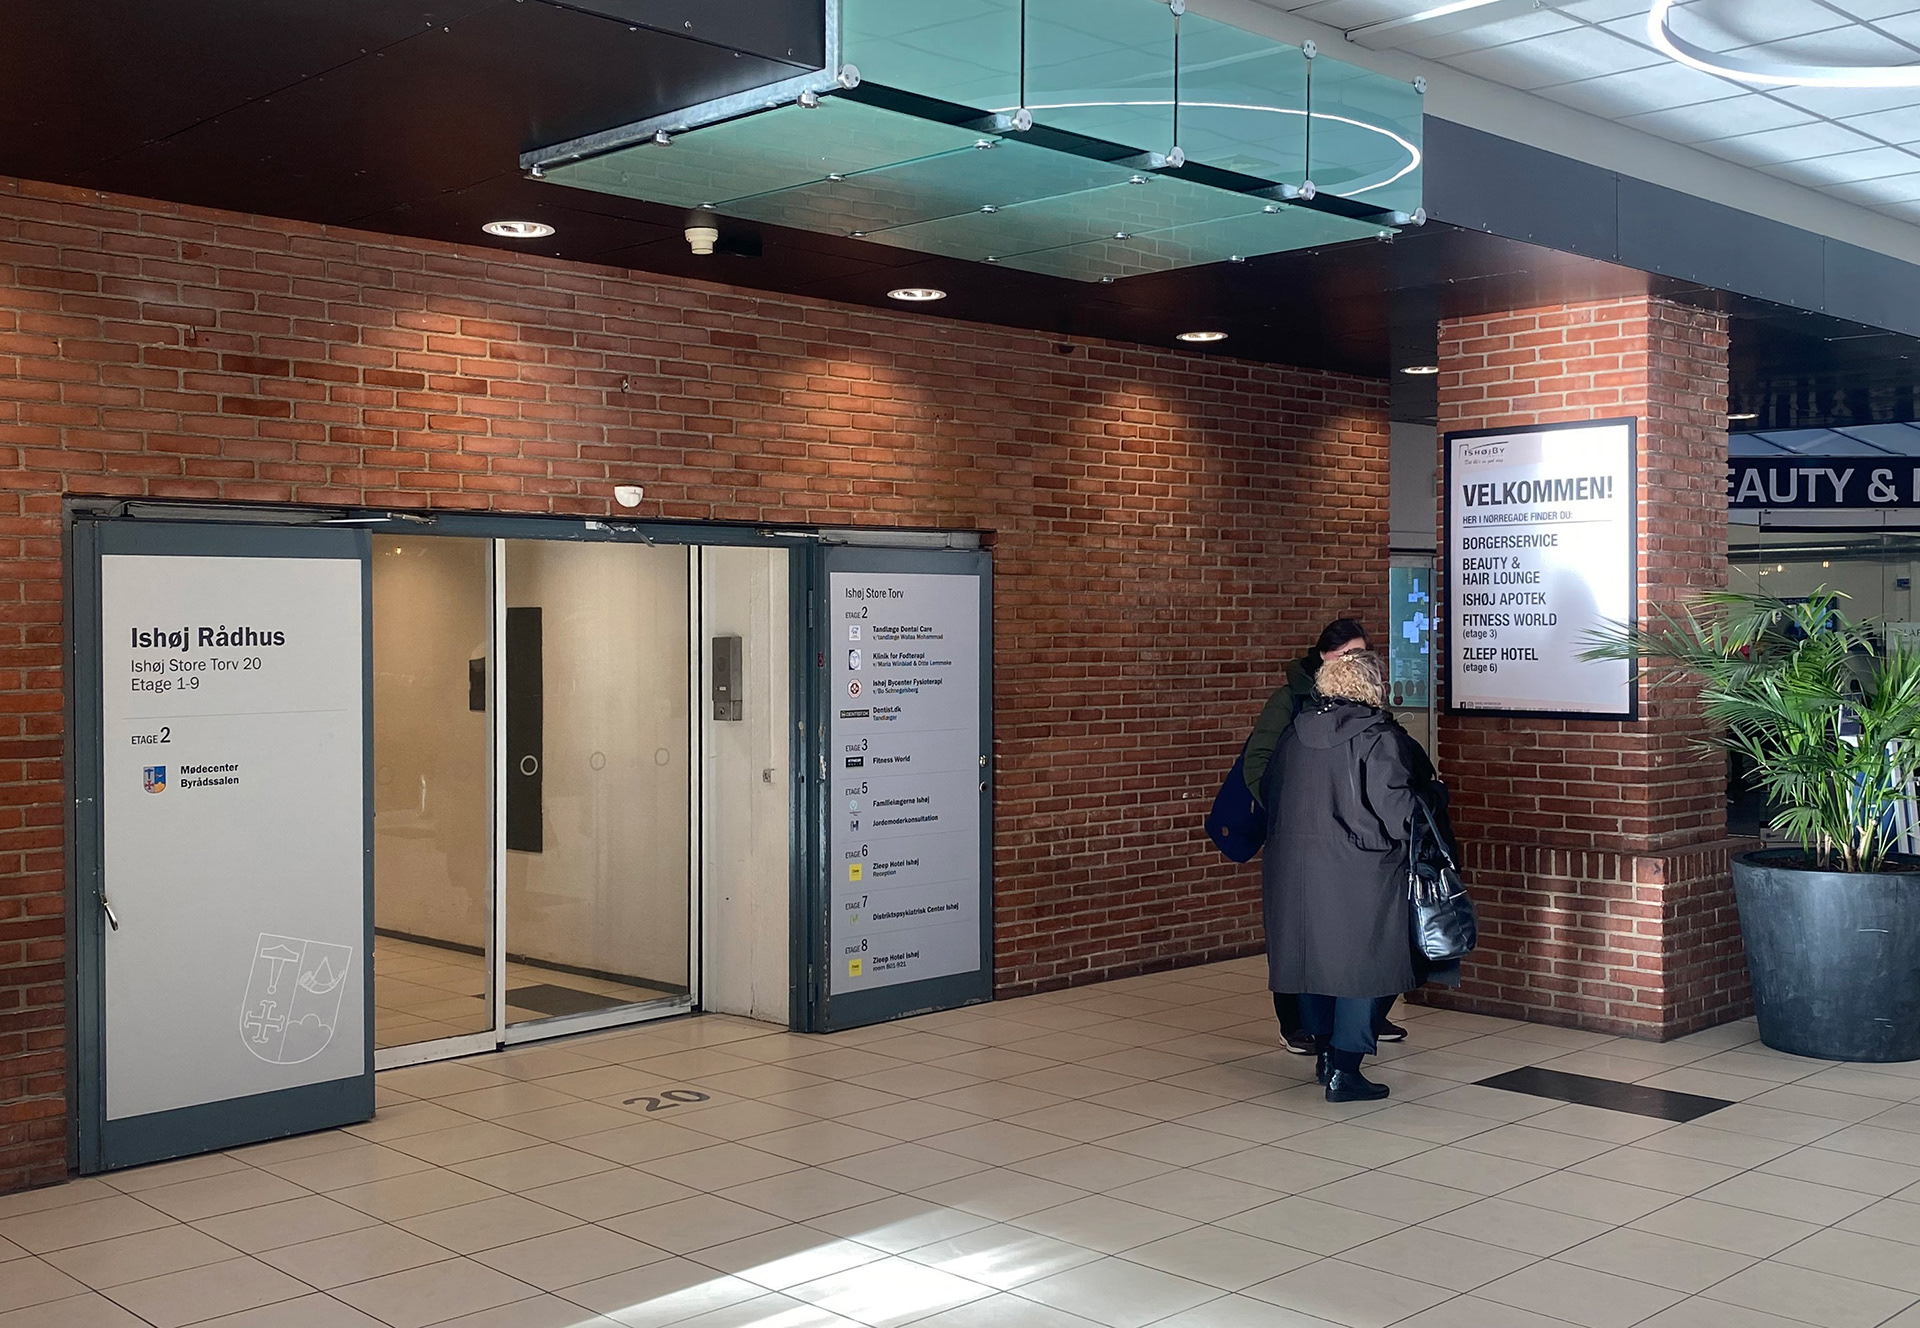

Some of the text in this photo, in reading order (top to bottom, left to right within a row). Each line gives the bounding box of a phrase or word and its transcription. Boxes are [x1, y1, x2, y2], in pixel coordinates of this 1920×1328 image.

[1463, 476, 1612, 506] VELKOMMEN!
[1868, 468, 1899, 503] &
[1463, 511, 1573, 524] HER I NØRREGADE FINDER DU:
[1463, 534, 1558, 550] BORGERSERVICE
[1463, 557, 1520, 571] BEAUTY &
[1463, 571, 1540, 585] HAIR LOUNGE
[846, 588, 904, 600] Ishøj Store Torv
[1463, 592, 1546, 606] ISHØJ APOTEK
[846, 606, 868, 619] ETAGE 2
[1463, 613, 1557, 626] FITNESS WORLD
[873, 626, 899, 634] Tandlæge
[1463, 629, 1497, 640] (etage 3)
[131, 625, 285, 652] Ishøj Rådhus
[1463, 648, 1538, 661] ZLEEP HOTEL
[131, 657, 261, 674] Ishøj Store Torv 20
[1463, 663, 1497, 673] (etage 6)
[131, 677, 199, 693] Etage 1-9
[888, 679, 912, 687] Bycenter
[873, 706, 901, 714] Dentist.dk
[131, 727, 171, 745] ETAGE 2
[846, 739, 868, 752] ETAGE 3
[180, 763, 239, 774] Mødecenter
[180, 776, 239, 789] Byrådssalen
[862, 782, 868, 794] 5
[917, 796, 929, 804] Ishøj
[862, 844, 868, 857] 6
[890, 860, 905, 868] Hotel
[906, 858, 919, 866] Ishøj
[845, 895, 868, 910] ETAGE 7
[927, 905, 945, 913] Center
[946, 903, 959, 911] Ishøj
[861, 939, 868, 951] 8
[890, 954, 905, 962] Hotel
[906, 950, 919, 959] Ishøj
[622, 1090, 711, 1112] 20
